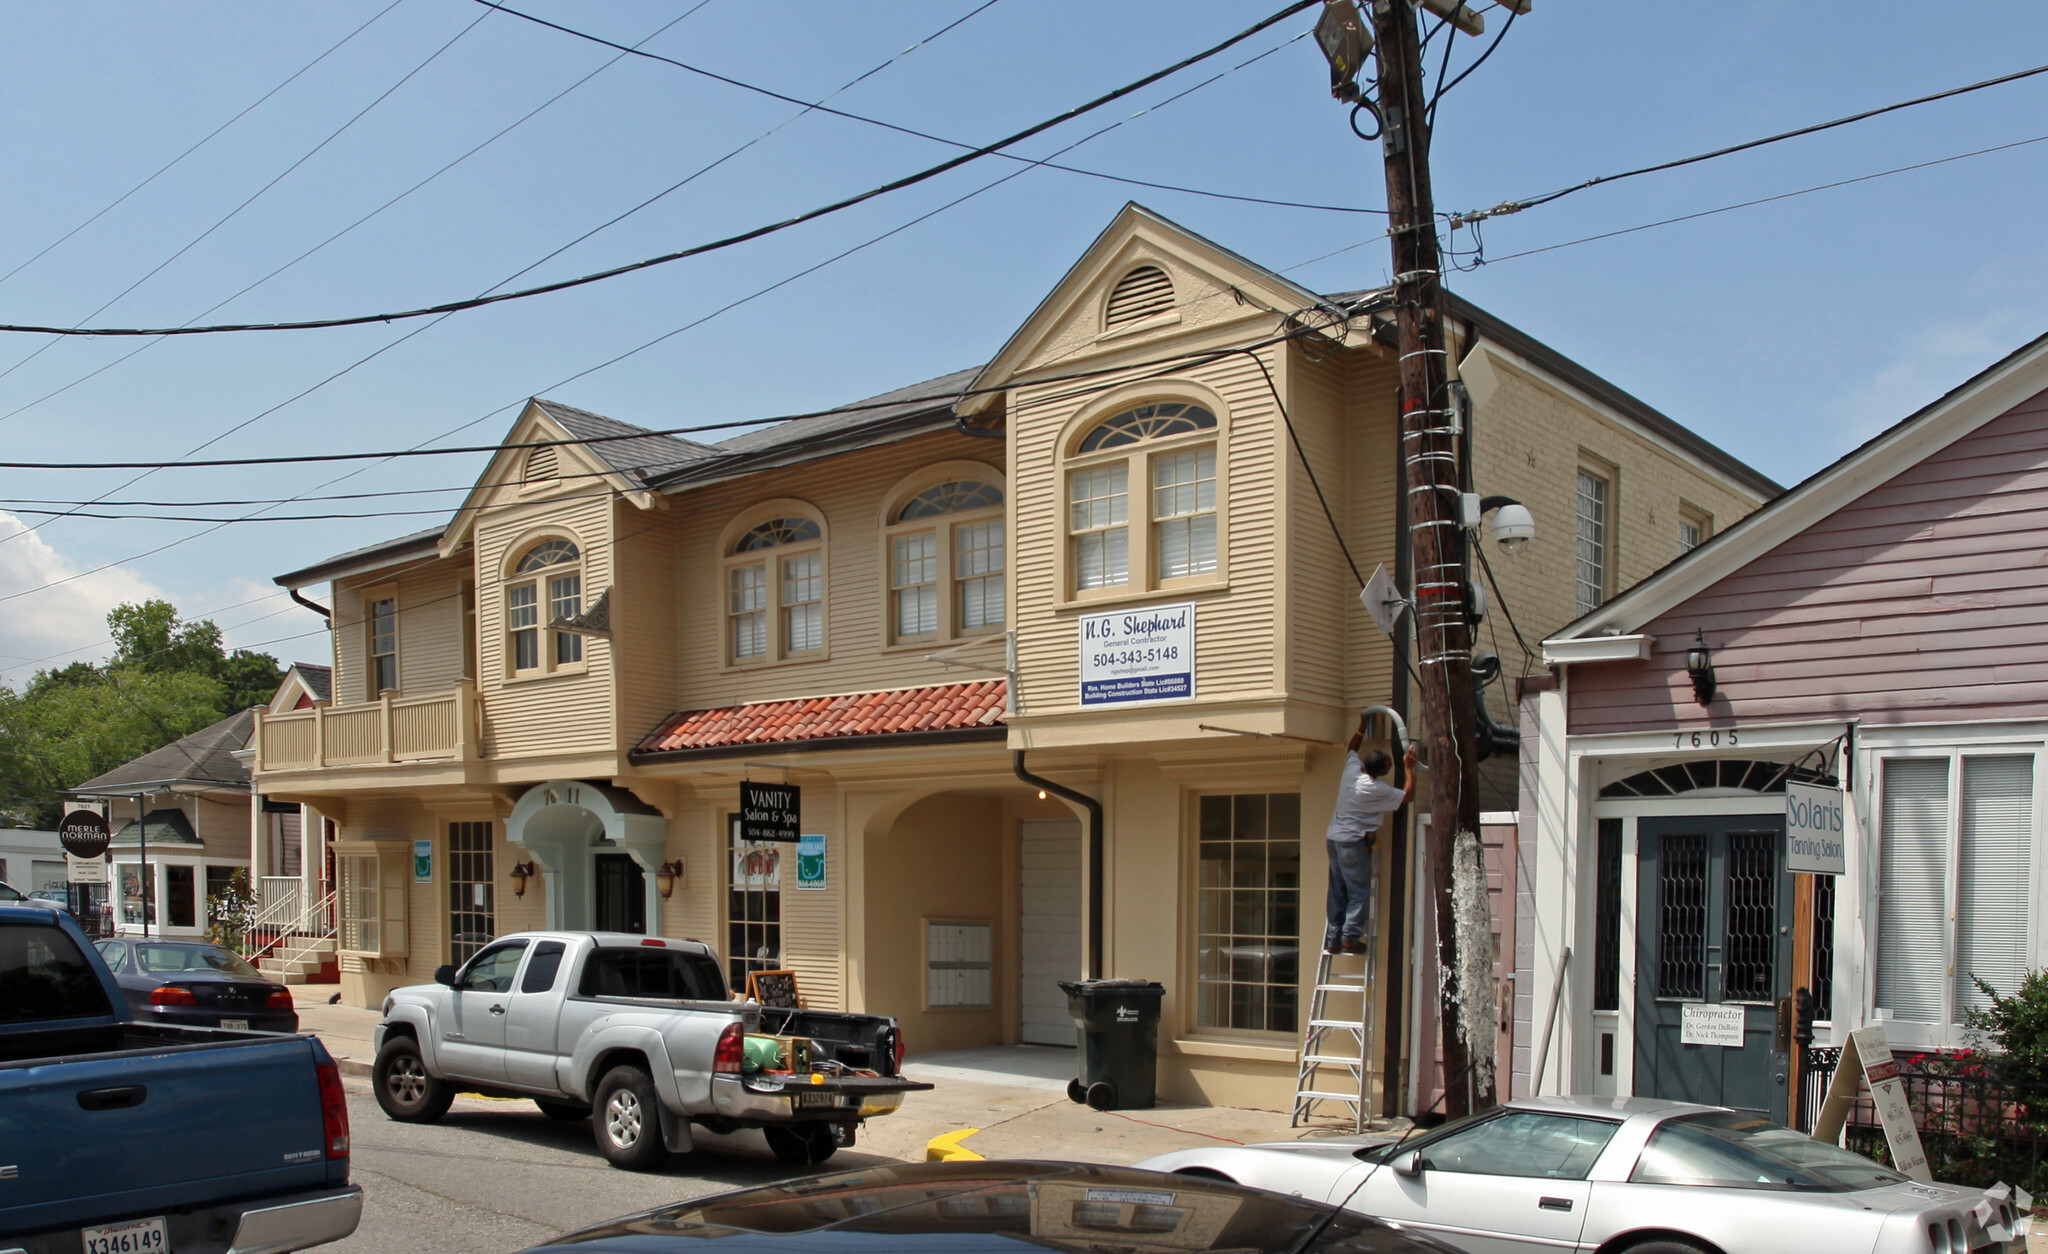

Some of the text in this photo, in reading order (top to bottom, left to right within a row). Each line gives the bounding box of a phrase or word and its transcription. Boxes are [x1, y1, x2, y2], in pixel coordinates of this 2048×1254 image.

[1086, 610, 1186, 640] N.G. Shephard
[1103, 634, 1167, 648] General Contractor
[1093, 646, 1178, 667] 504-343-5148
[1085, 691, 1106, 700] Building
[1107, 688, 1143, 698] Construction
[1144, 686, 1158, 695] State
[1100, 683, 1116, 691] Home
[1117, 680, 1140, 689] Builders
[1141, 679, 1155, 687] State
[1673, 729, 1738, 749] 7605
[750, 789, 792, 809] VANITY
[744, 808, 797, 827] Salon & Spa
[1789, 794, 1842, 832] Solaris
[61, 831, 107, 840] NORMAN
[67, 824, 101, 833] MERLE
[1789, 835, 1842, 860] Tanning Salon
[1683, 1007, 1743, 1021] Chiropractor
[1696, 1031, 1710, 1039] Nick
[1710, 1032, 1739, 1041] Thompson
[88, 1229, 161, 1254] X346149
